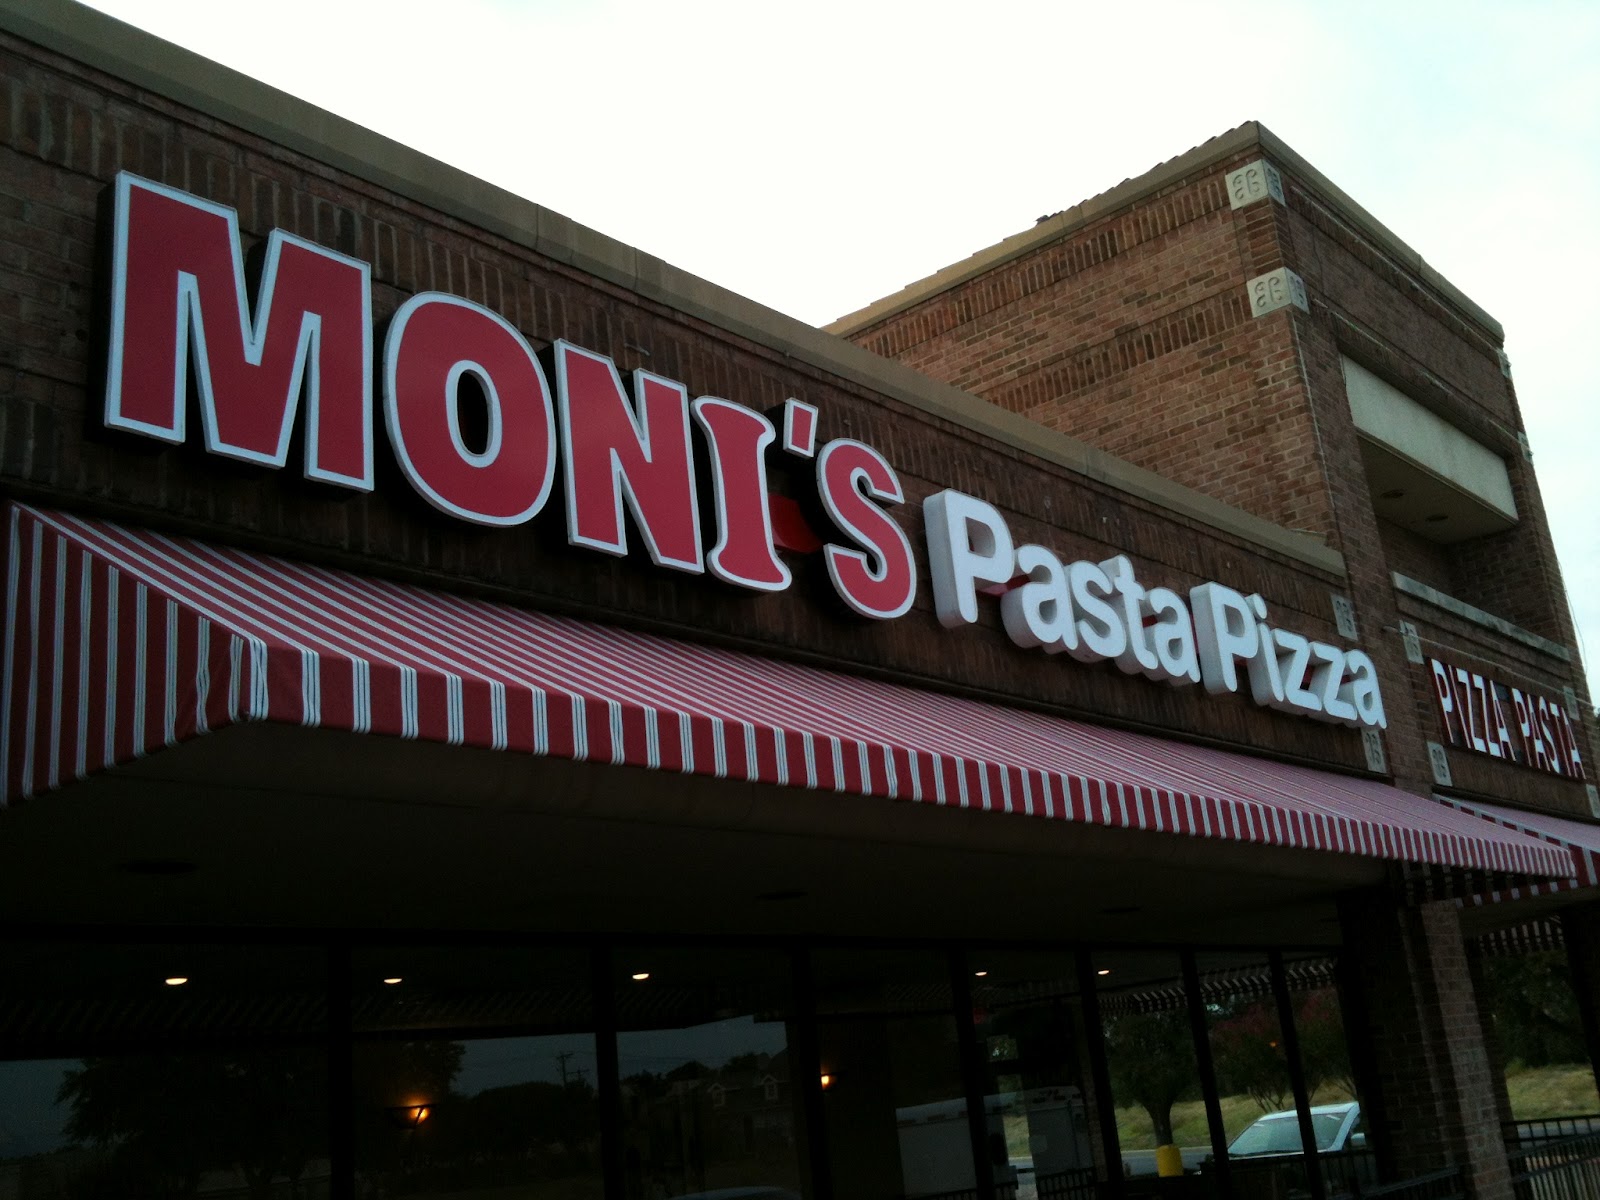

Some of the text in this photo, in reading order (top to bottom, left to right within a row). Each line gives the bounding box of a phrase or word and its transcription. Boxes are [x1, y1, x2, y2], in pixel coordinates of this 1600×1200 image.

[925, 488, 1201, 684] Pasta
[1191, 581, 1387, 729] Pizza
[1429, 657, 1587, 780] PIZZA PASTA
